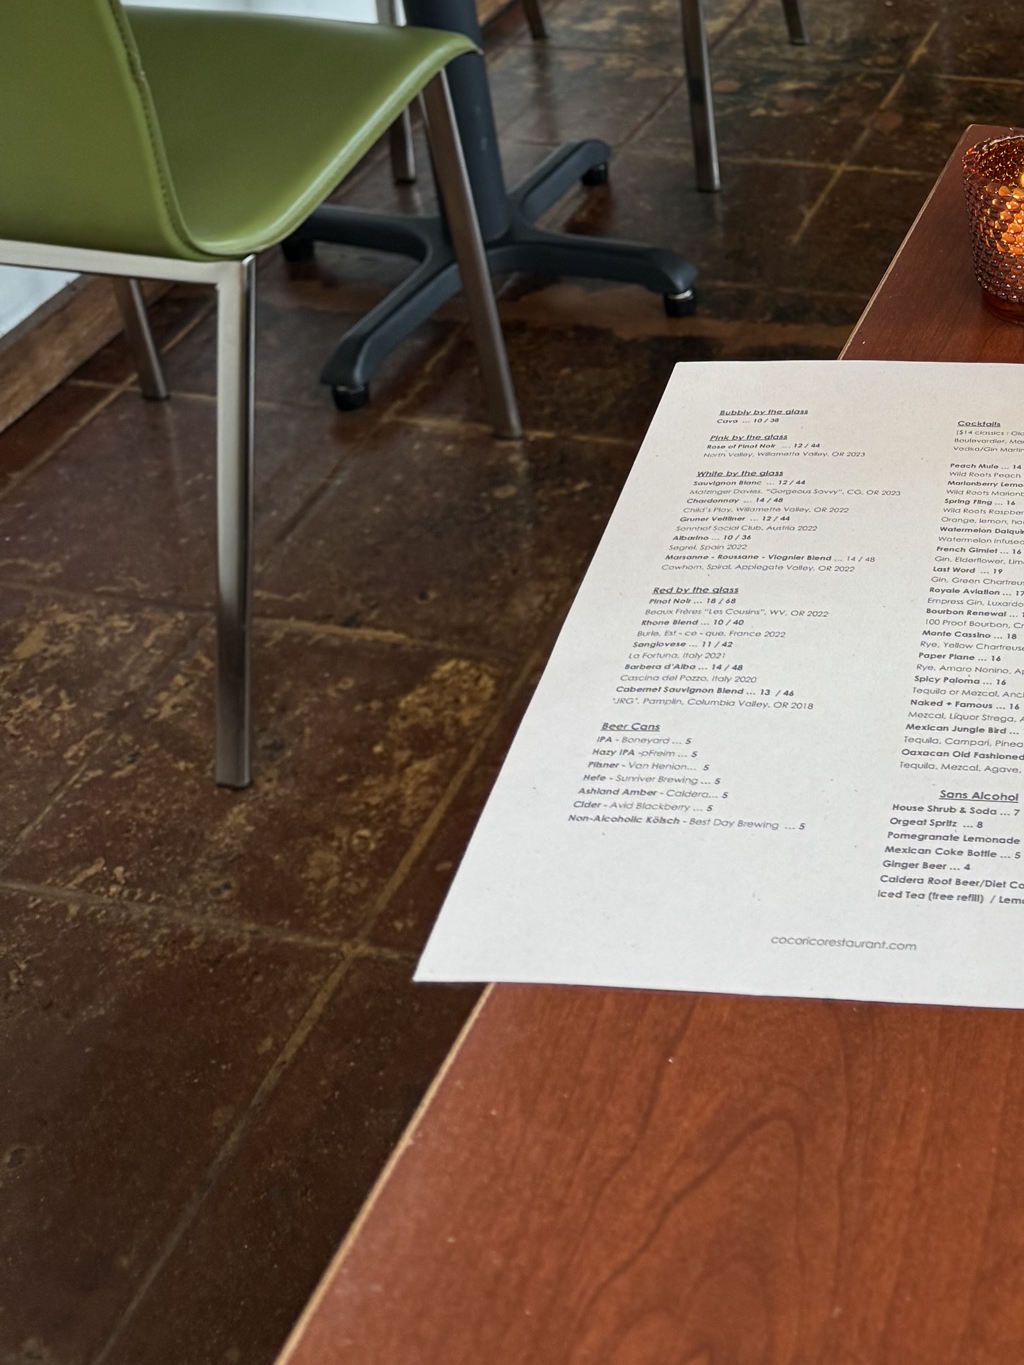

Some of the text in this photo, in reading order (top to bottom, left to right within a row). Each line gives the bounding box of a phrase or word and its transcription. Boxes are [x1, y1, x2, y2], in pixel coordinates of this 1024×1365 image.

[652, 586, 739, 594] Red by the glass
[929, 586, 960, 594] Royale
[925, 607, 964, 615] Bourbon
[954, 630, 991, 638] Cassino
[632, 640, 686, 648] Sangiovese
[918, 651, 946, 659] Paper
[914, 674, 940, 684] Spicy
[943, 675, 980, 684] Paloma
[663, 685, 714, 694] Sauvignon
[954, 700, 992, 708] Famous
[601, 722, 660, 732] Beer Cans
[905, 723, 949, 731] Mexican
[951, 725, 985, 734] Jungle
[987, 726, 1006, 734] Bird
[621, 736, 670, 744] Boneyard
[591, 748, 617, 756] Hazy
[901, 748, 949, 757] Oaxacan
[973, 751, 1024, 760] Fashioned
[628, 761, 649, 769] Van
[582, 773, 606, 781] Hefe
[615, 774, 655, 782] Sunriver
[657, 775, 698, 785] Brewing
[577, 787, 620, 795] Ashland
[621, 788, 657, 796] Amber
[939, 789, 1019, 802] Sans Alcohol
[572, 800, 601, 808] Cider
[609, 801, 633, 809] Avid
[635, 802, 690, 812] Blackberry
[892, 803, 924, 811] House
[926, 804, 956, 813] Shrub
[969, 806, 996, 815] Soda
[1014, 808, 1020, 816] 7
[567, 814, 805, 830] Non-Alcoholic Kölsch Best Day Brewing 5
[889, 817, 983, 828] Orgeat Spritz 8
[887, 831, 959, 841] Pomegranate
[962, 834, 1020, 844] Lemonade
[884, 845, 1020, 859] Mexican Coke Bottle 5
[882, 859, 919, 870] Ginger
[921, 861, 946, 869] Beer
[879, 874, 924, 884] Caldera
[927, 876, 952, 885] Root
[954, 877, 1006, 888] Beer/Diet
[877, 889, 903, 898] Iced
[905, 890, 925, 899] Tea
[927, 891, 954, 901] (free
[956, 893, 984, 903] refill)
[770, 936, 916, 950] cocoricorestaurant.com
